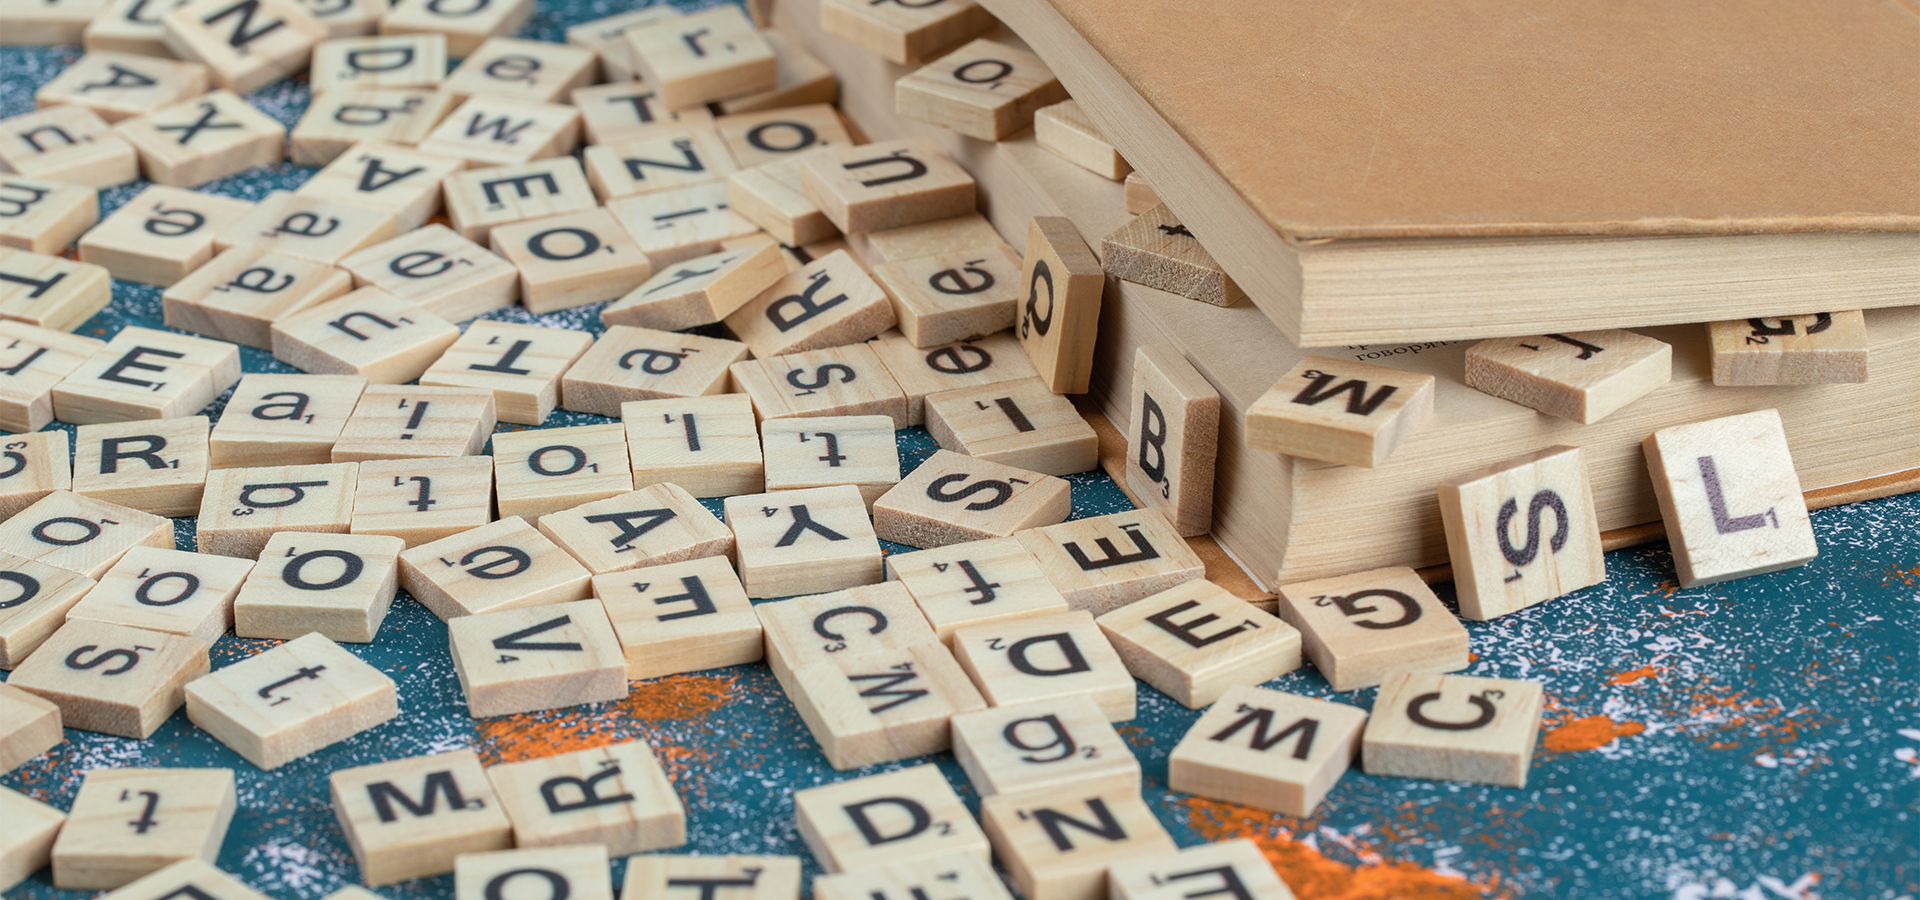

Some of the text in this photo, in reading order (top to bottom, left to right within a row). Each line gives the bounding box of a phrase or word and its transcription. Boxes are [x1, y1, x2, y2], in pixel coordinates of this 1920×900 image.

[481, 172, 560, 203] E
[277, 212, 340, 238] a
[226, 267, 295, 294] a
[389, 251, 454, 279] e
[928, 266, 996, 296] e
[765, 274, 849, 333] R
[328, 311, 398, 342] n
[98, 345, 185, 388] E
[468, 339, 533, 376] T
[618, 347, 688, 376] a
[925, 344, 993, 375] e
[251, 391, 311, 421] a
[99, 434, 170, 475] R
[814, 431, 847, 468] t
[1138, 390, 1167, 484] B
[408, 475, 436, 512] t
[1697, 455, 1766, 535] L
[583, 507, 678, 549] A
[774, 504, 850, 548] Y
[459, 545, 533, 580] e
[1062, 528, 1162, 572] E
[653, 575, 718, 622] F
[1144, 599, 1247, 649] E
[1006, 632, 1093, 677] D
[257, 664, 327, 699] t
[1002, 714, 1077, 764] g
[366, 770, 470, 824] M
[539, 764, 636, 815] R
[127, 790, 161, 834] t
[843, 796, 933, 847] D
[1031, 797, 1128, 853] N
